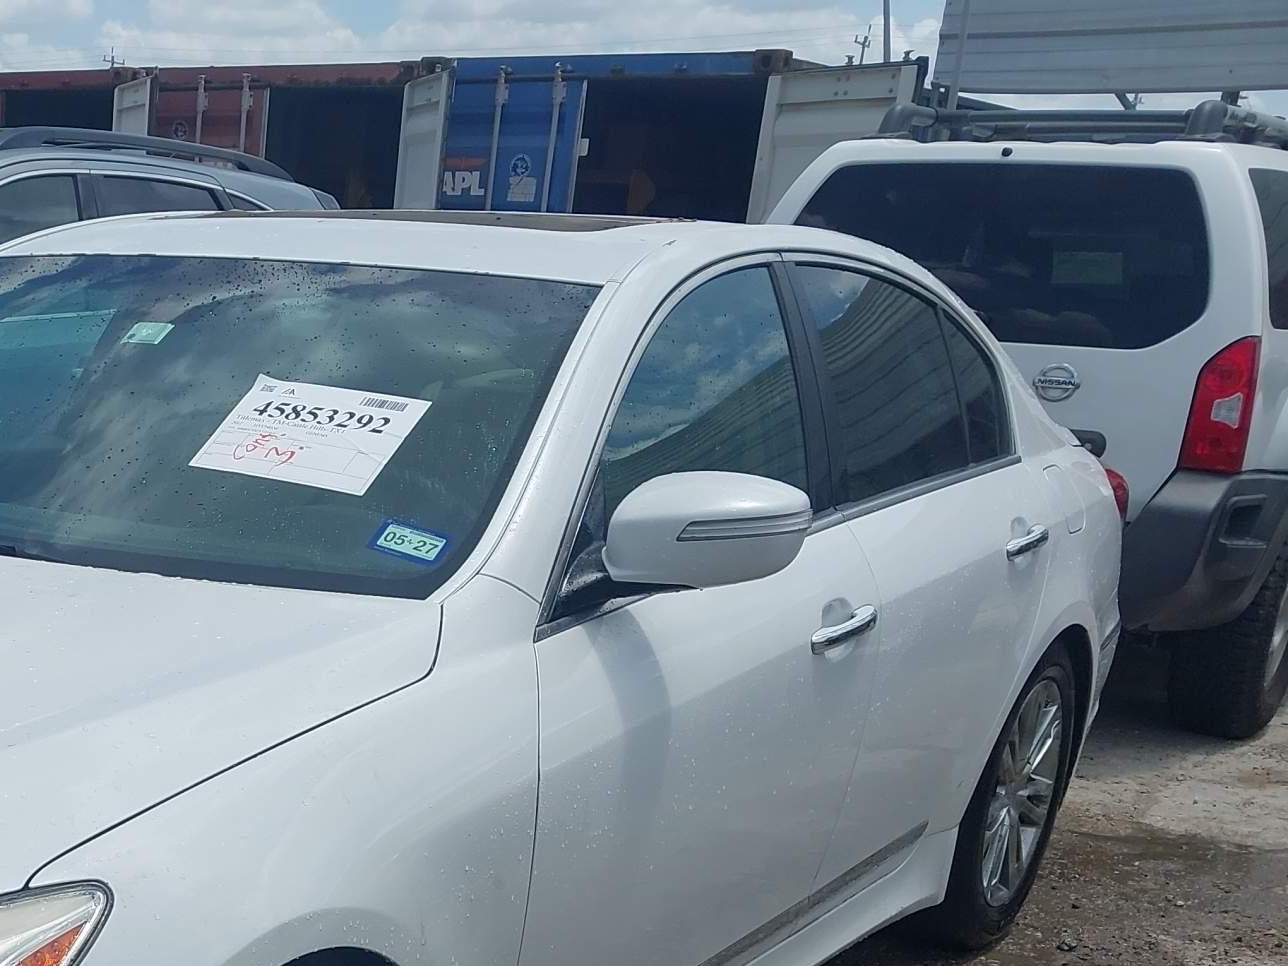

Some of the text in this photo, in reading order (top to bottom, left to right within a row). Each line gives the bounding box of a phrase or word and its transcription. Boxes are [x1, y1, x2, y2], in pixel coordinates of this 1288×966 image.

[443, 171, 485, 196] APL
[1037, 378, 1076, 386] NISSAN
[253, 400, 391, 434] 45853292
